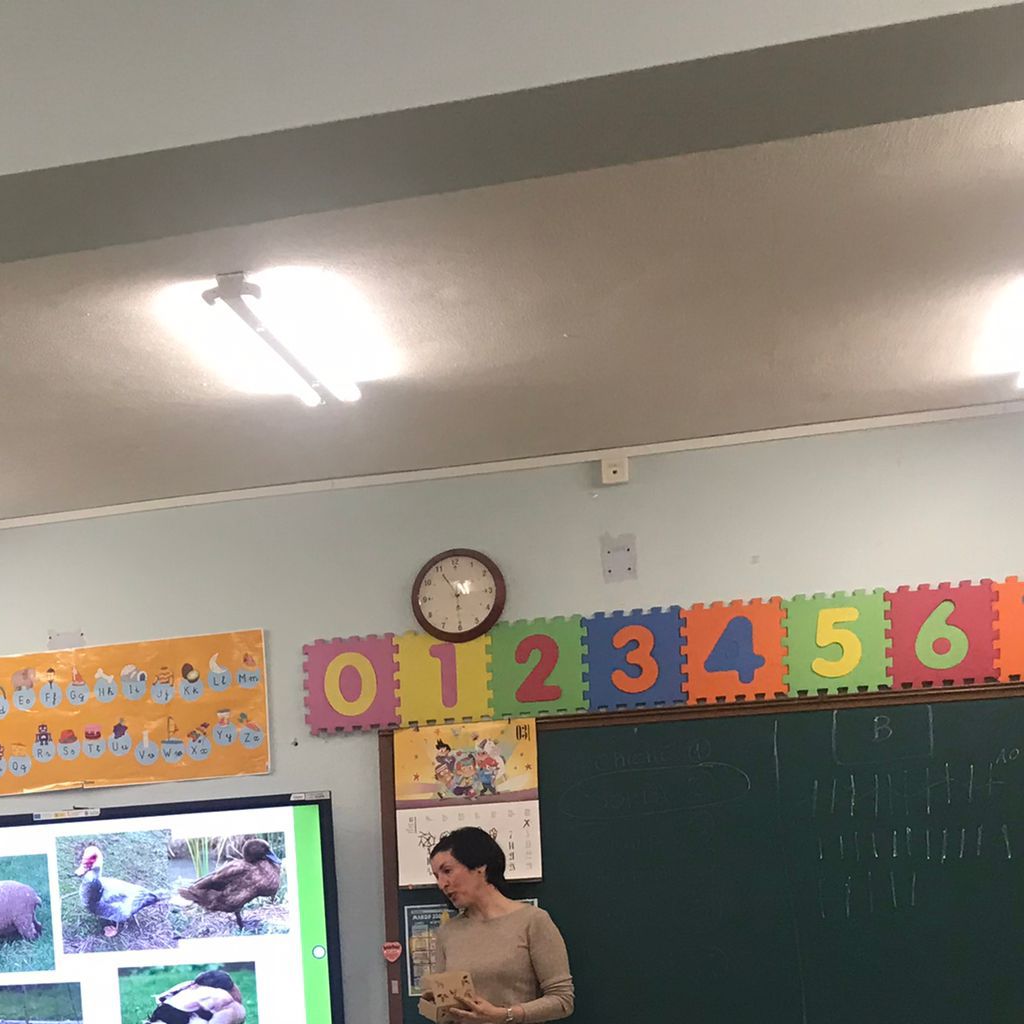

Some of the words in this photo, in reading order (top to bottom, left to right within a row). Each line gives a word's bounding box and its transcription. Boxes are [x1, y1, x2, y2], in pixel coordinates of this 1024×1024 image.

[324, 652, 377, 716] 0
[429, 643, 458, 708] 1
[515, 634, 562, 703] 2
[611, 625, 659, 694] 3
[704, 616, 765, 684] 4
[811, 607, 862, 678] 5
[915, 599, 969, 669] 6
